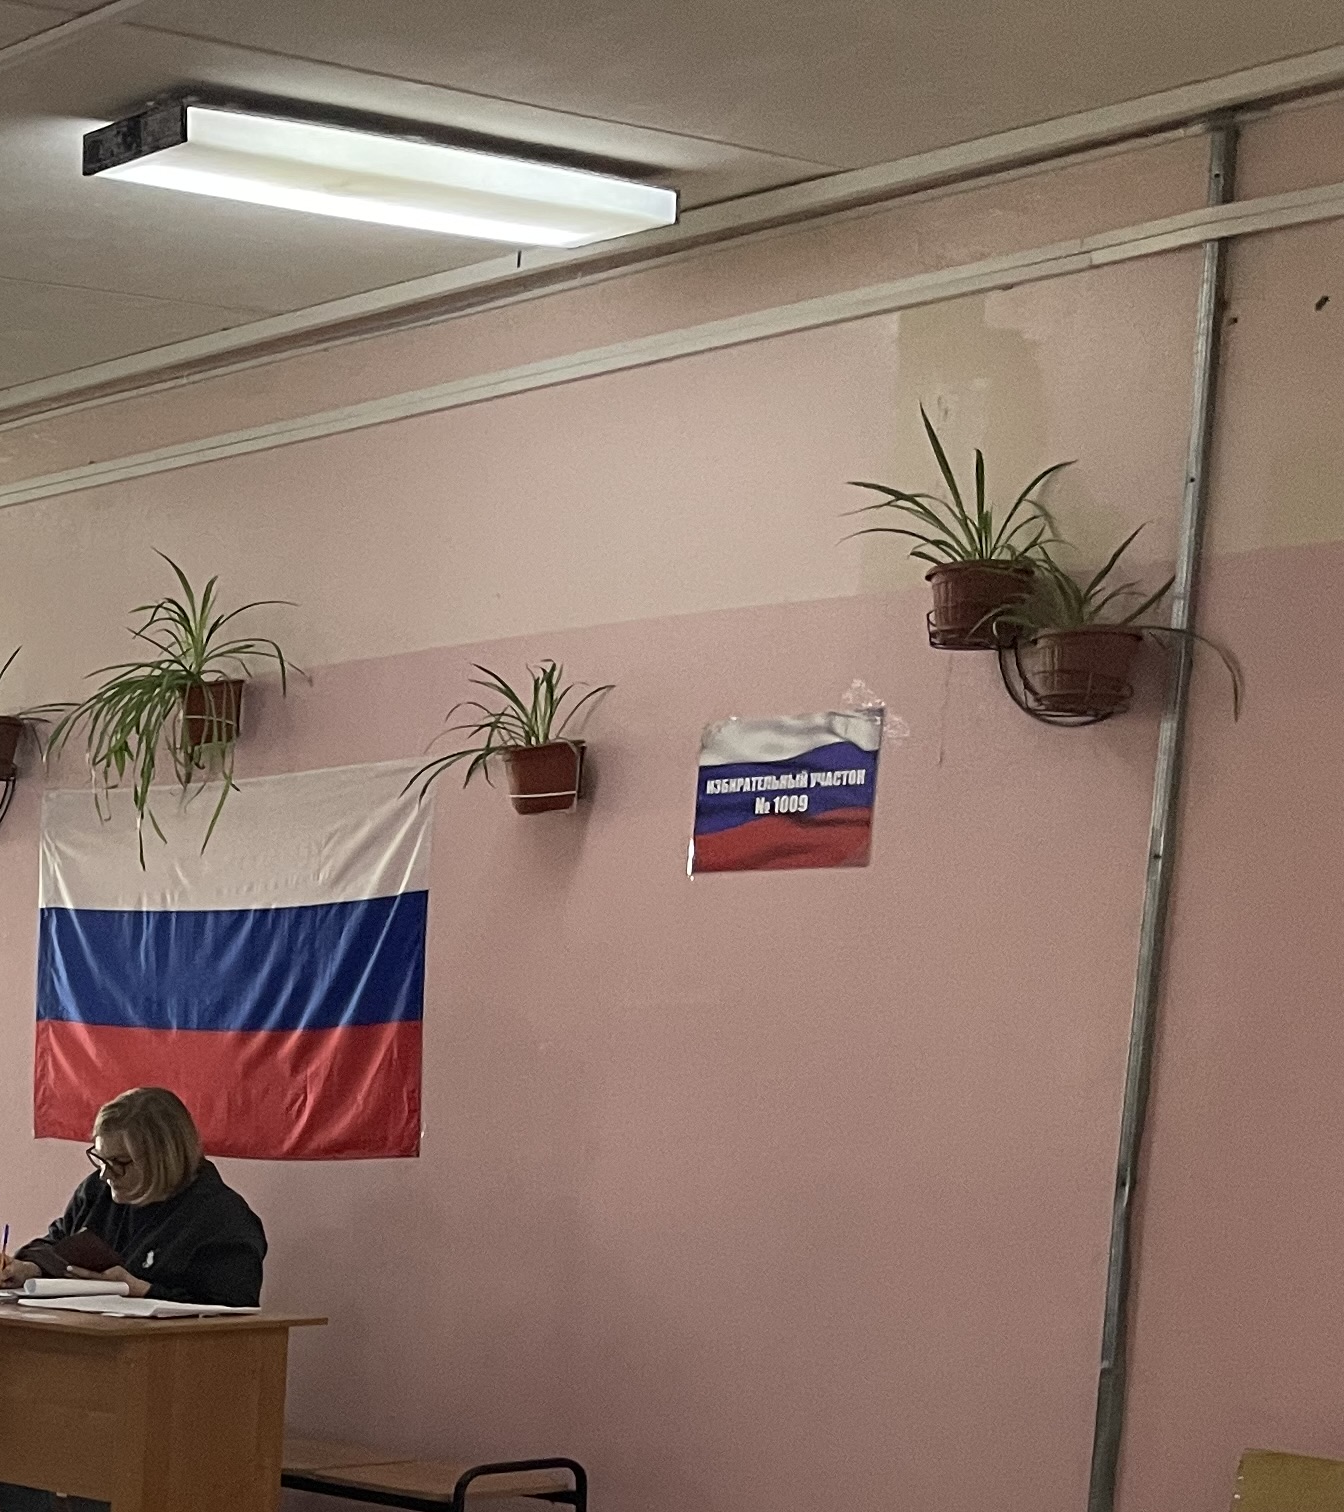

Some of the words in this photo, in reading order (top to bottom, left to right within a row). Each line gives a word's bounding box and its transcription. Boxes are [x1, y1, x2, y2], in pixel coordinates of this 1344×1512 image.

[706, 770, 809, 795] ИЗБИРАТЕЛЬНЫЙ
[754, 796, 771, 815] №
[773, 795, 809, 814] 1009
